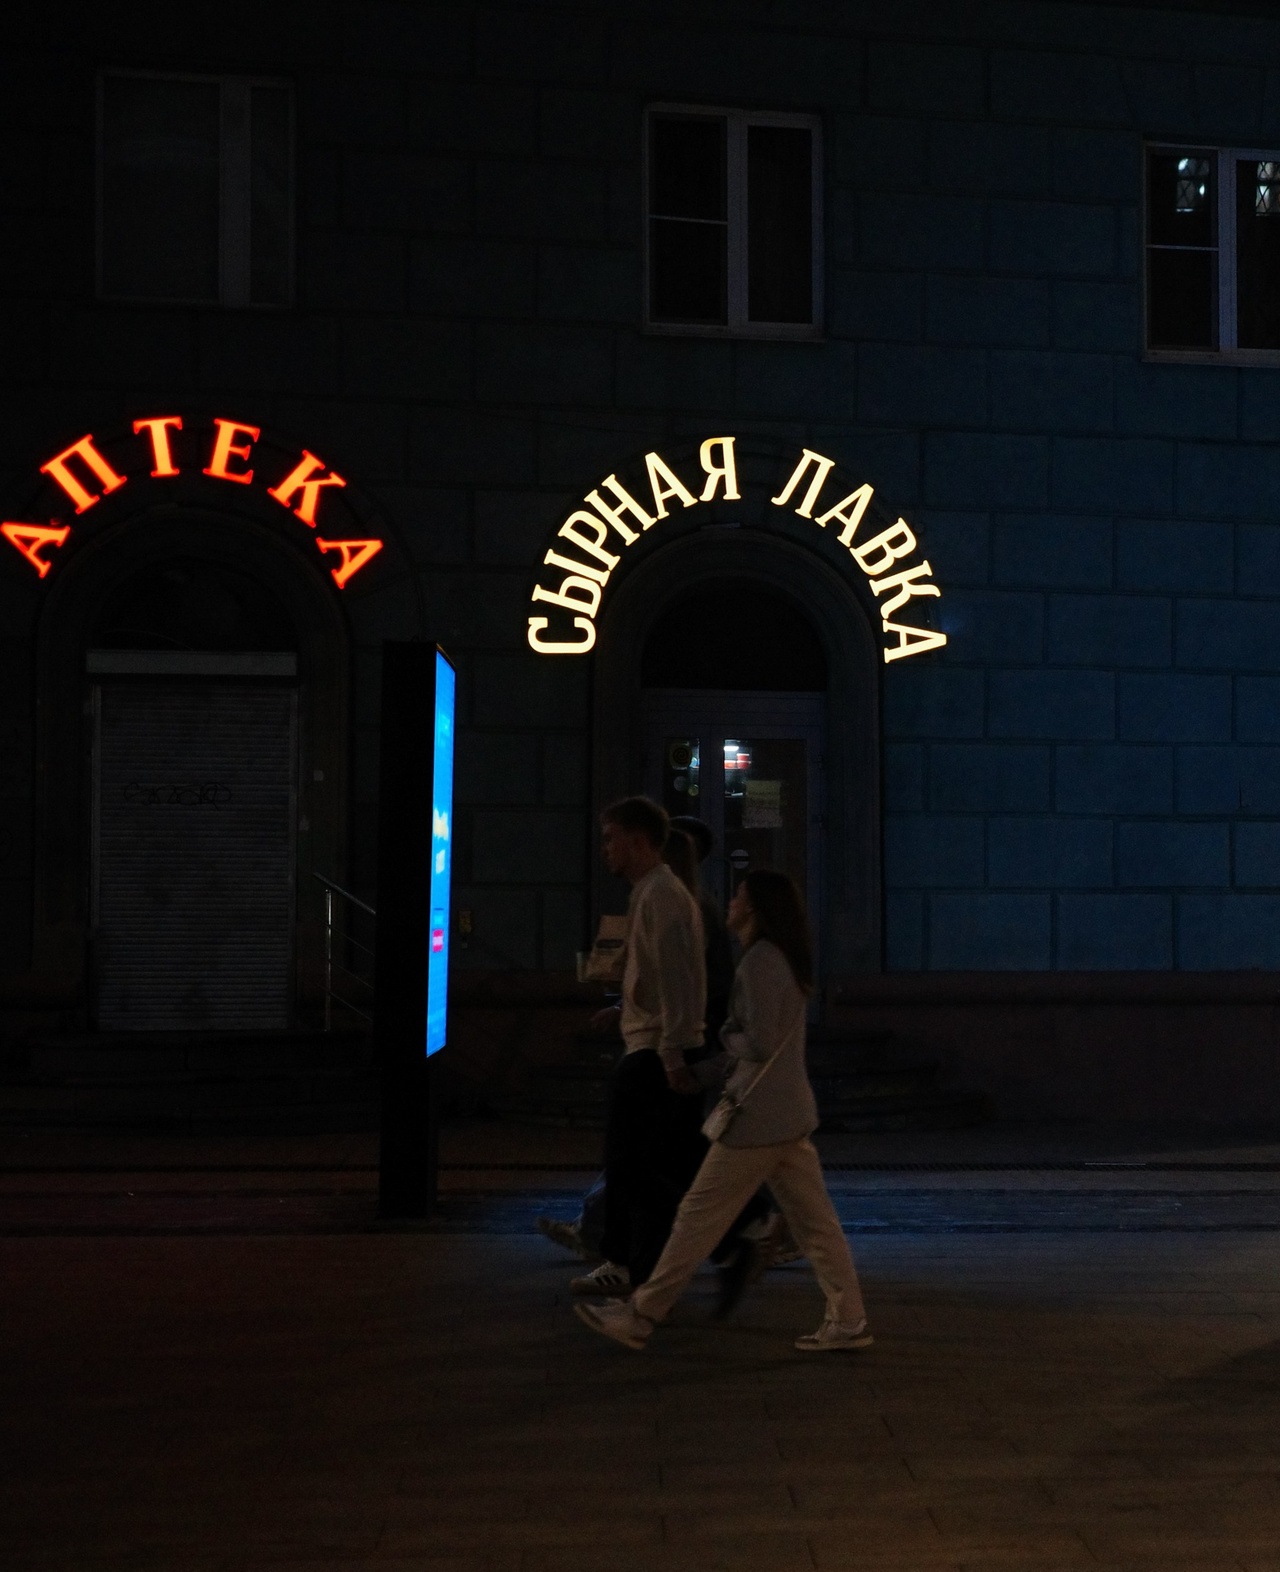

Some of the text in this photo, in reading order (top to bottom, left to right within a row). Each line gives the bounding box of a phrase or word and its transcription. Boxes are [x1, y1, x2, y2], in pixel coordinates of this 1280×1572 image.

[0, 415, 384, 590] АПТЕКА
[526, 436, 948, 664] СЫРНАЯ ЛАВКА
